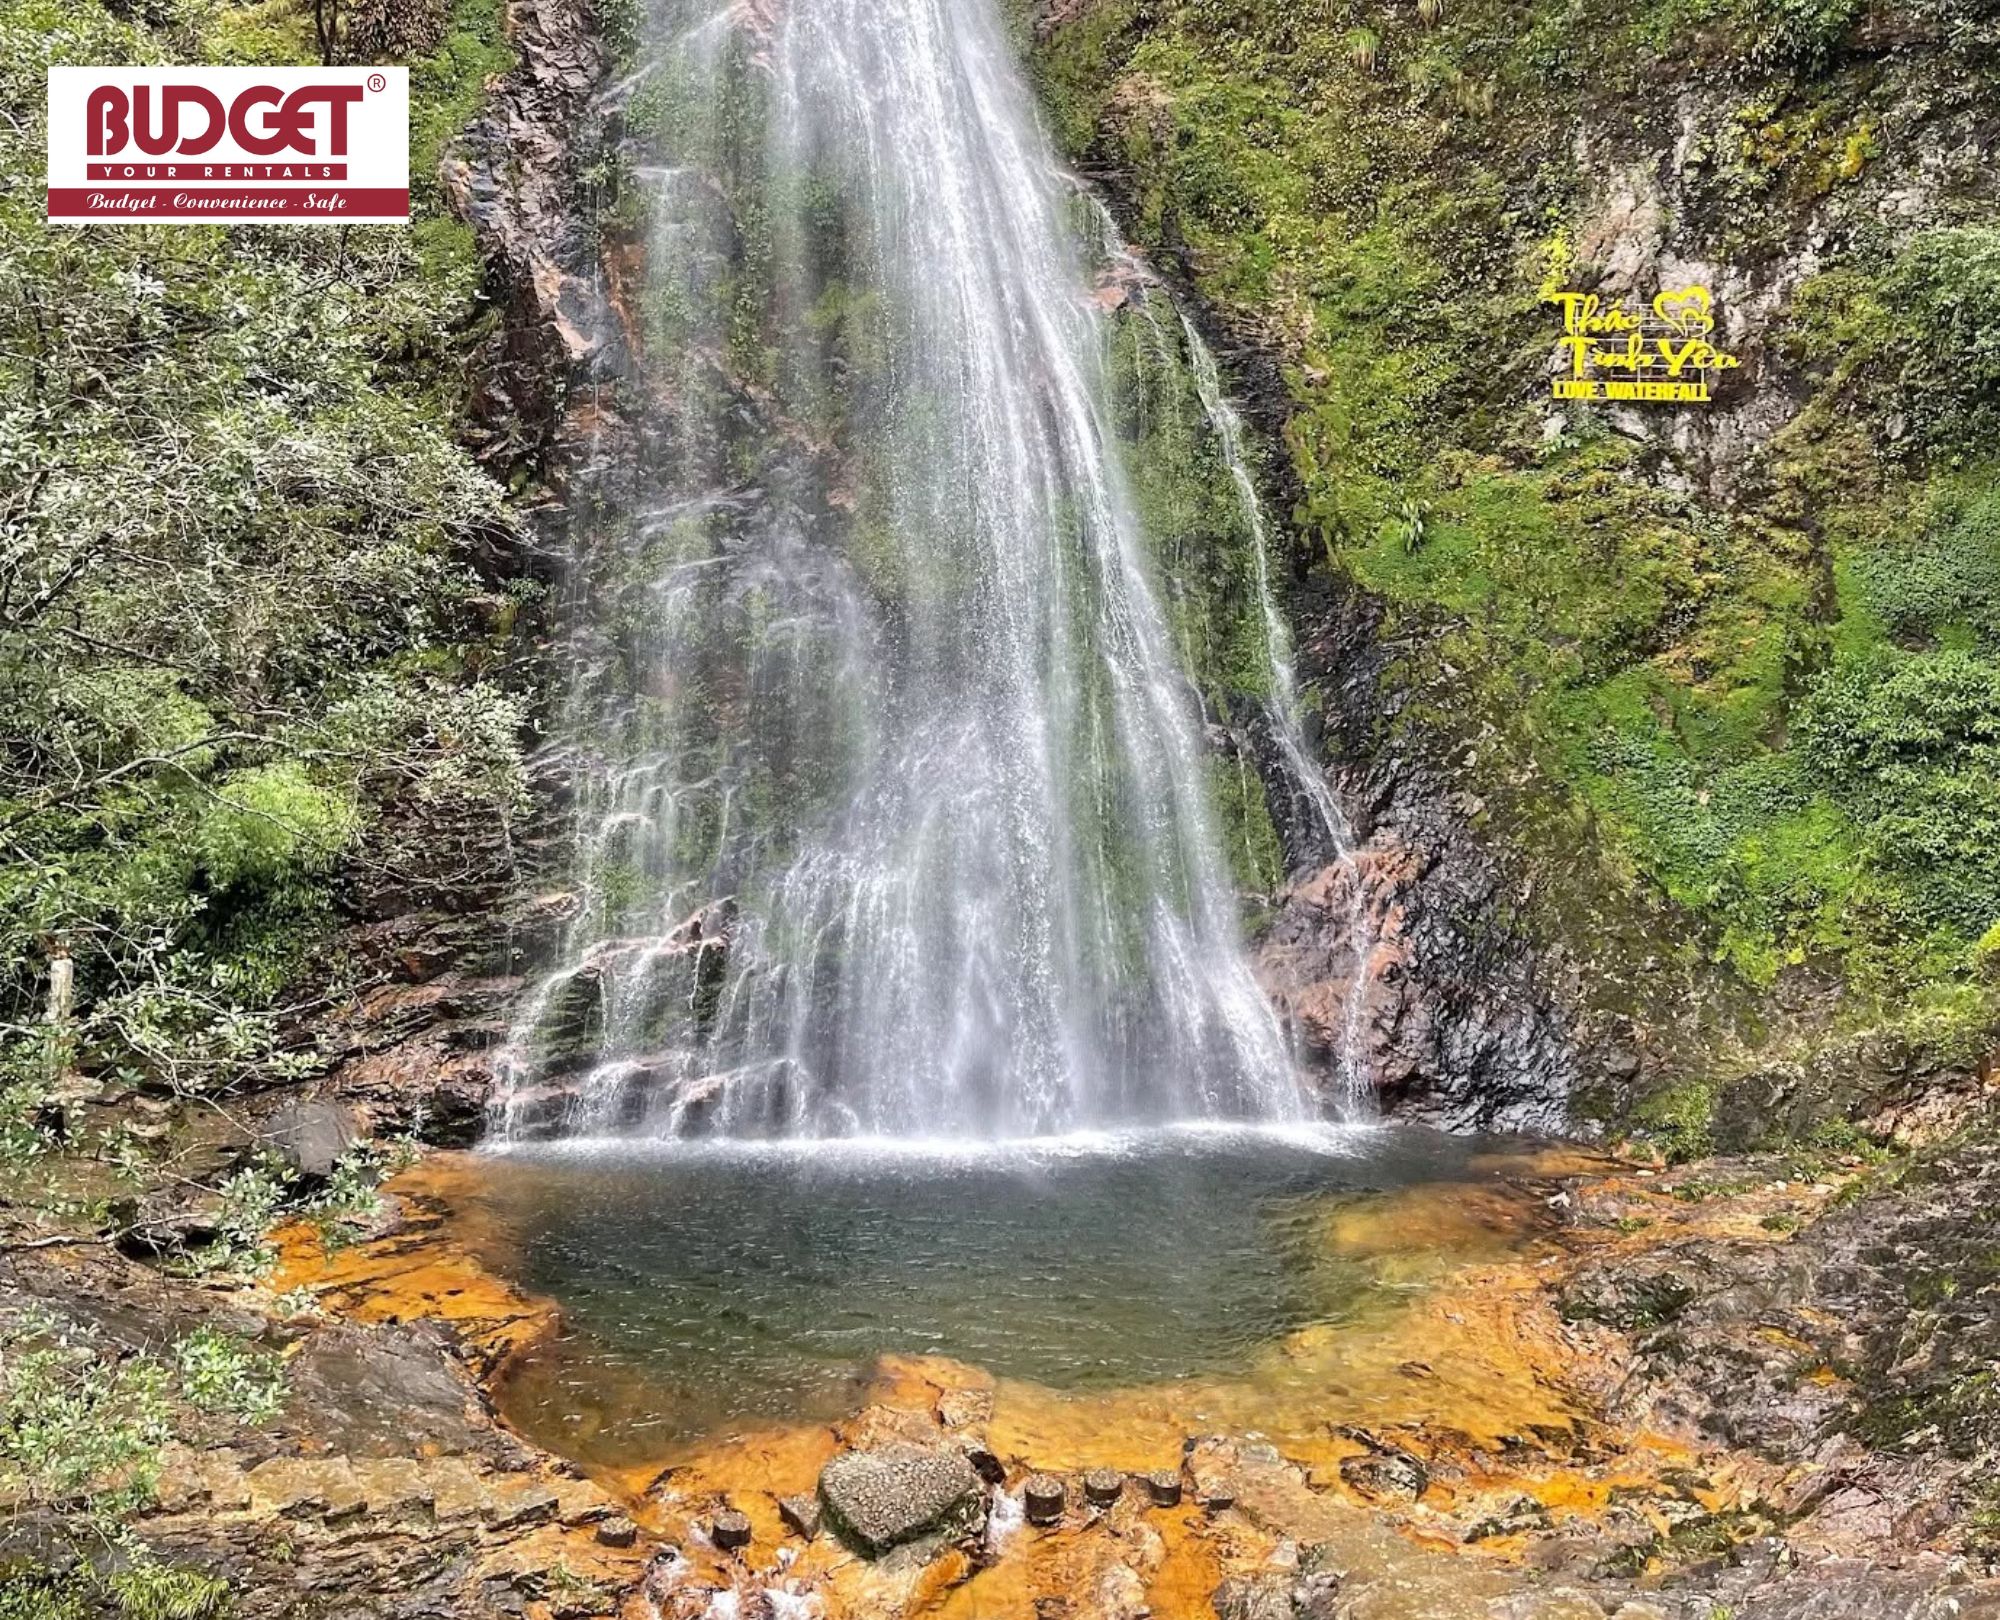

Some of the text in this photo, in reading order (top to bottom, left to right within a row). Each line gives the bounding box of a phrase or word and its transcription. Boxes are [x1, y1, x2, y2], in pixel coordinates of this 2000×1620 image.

[1550, 292, 1641, 335] Thác
[1553, 382, 1710, 400] LOVE WATERFALL
